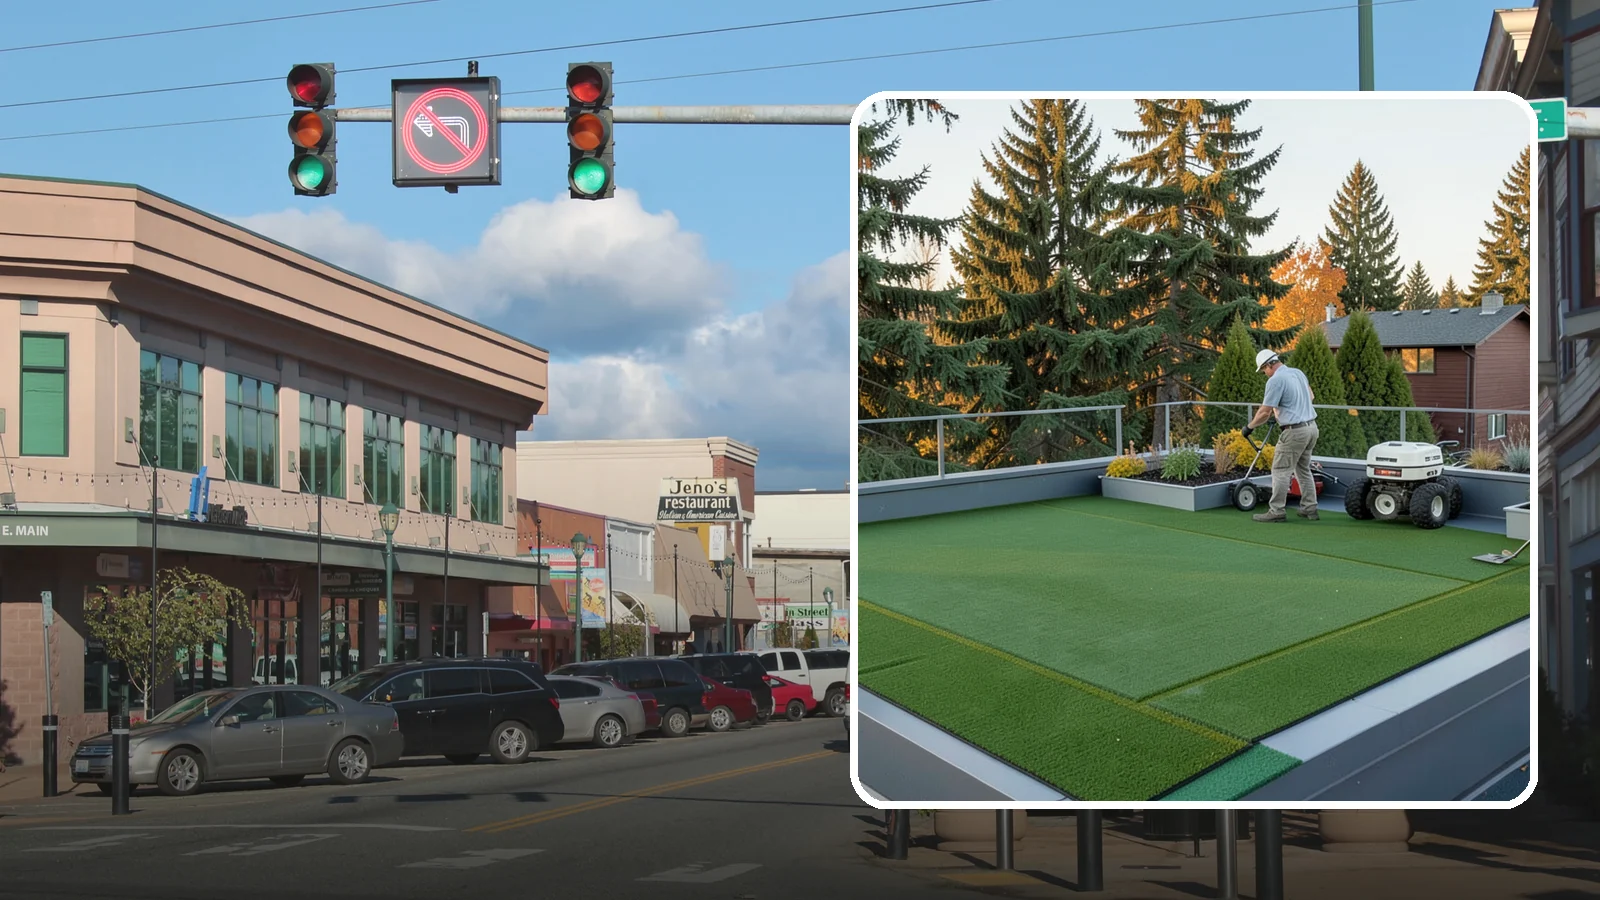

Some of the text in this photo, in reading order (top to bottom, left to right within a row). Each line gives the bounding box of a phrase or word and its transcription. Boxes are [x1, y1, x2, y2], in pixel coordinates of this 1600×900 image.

[669, 479, 728, 494] Jeno's
[664, 496, 731, 509] restaurant
[659, 509, 682, 520] Italian
[686, 509, 714, 520] American
[714, 509, 737, 520] Cuisine
[2, 525, 49, 537] E. MAIN
[797, 607, 829, 617] Street
